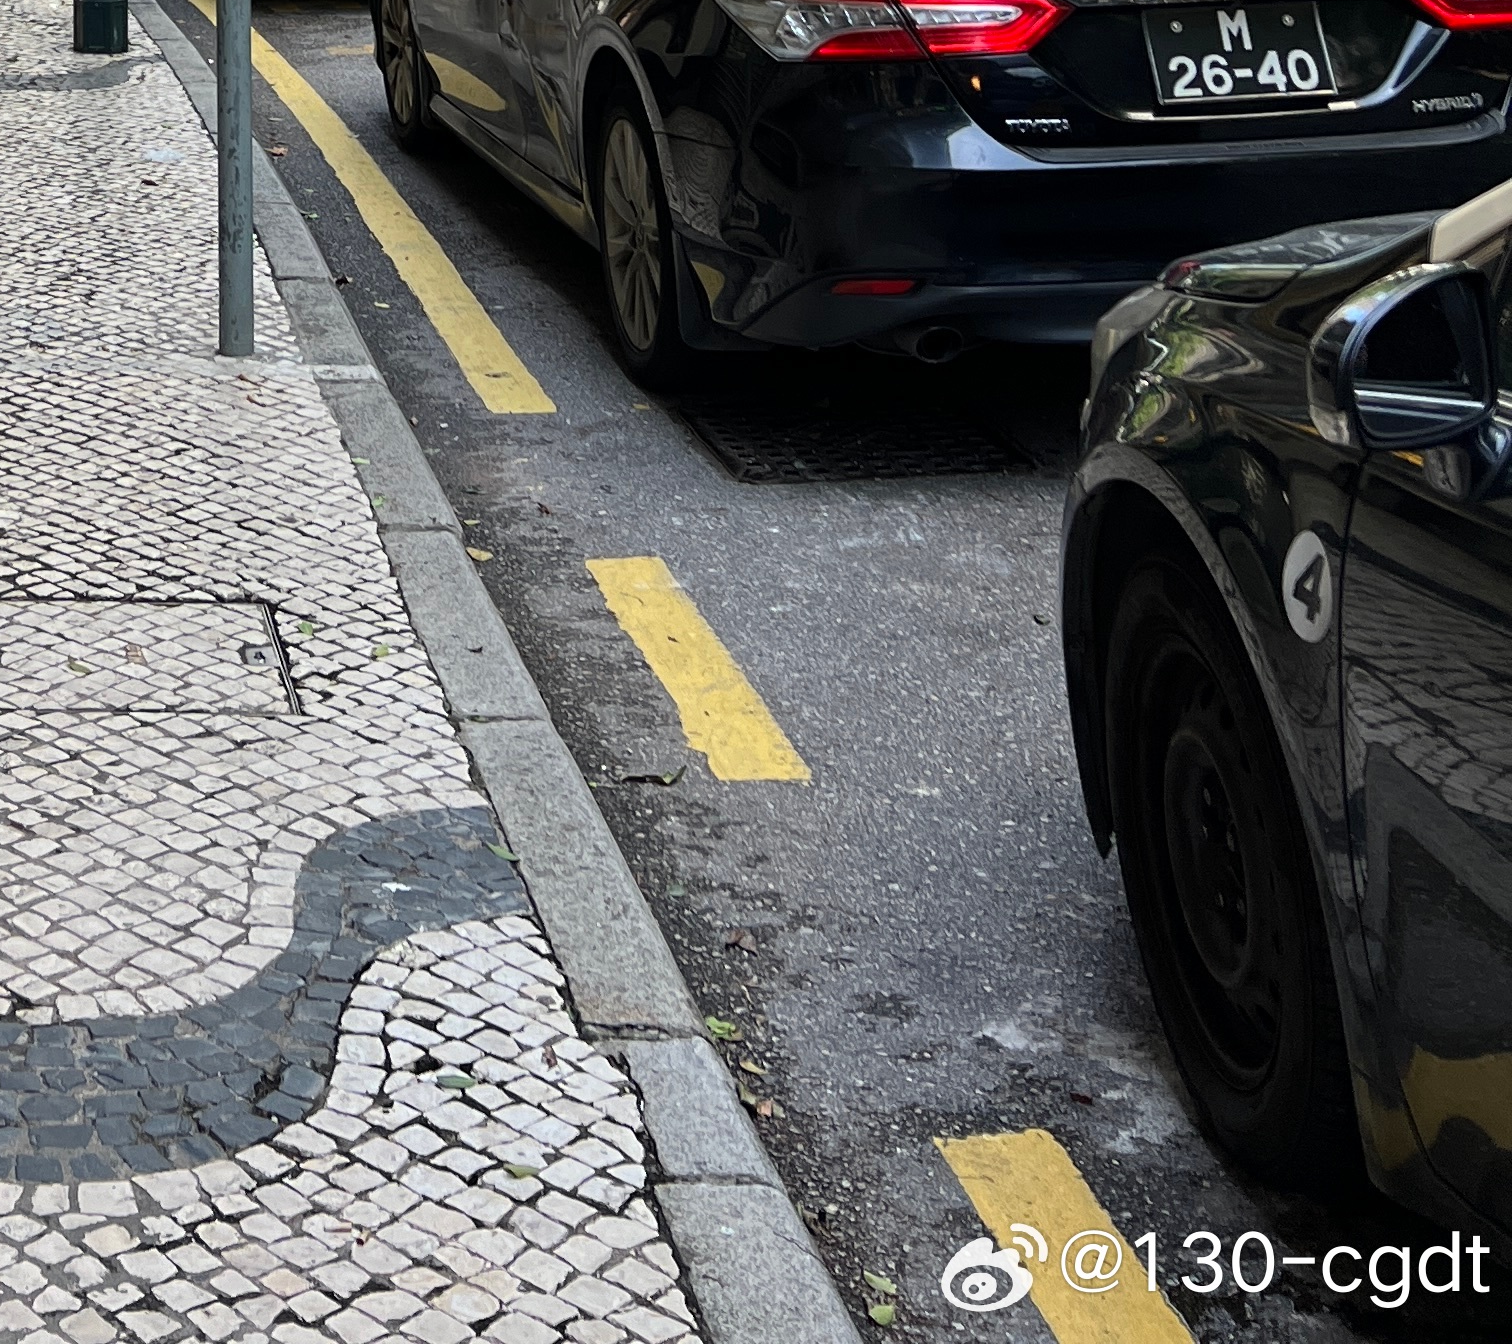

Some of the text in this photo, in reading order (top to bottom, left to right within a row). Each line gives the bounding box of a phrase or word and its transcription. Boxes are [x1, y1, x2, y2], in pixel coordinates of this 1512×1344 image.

[1217, 10, 1253, 52] M
[1168, 49, 1319, 97] 26-40
[1412, 95, 1476, 113] HYBRID
[1293, 552, 1325, 625] 4
